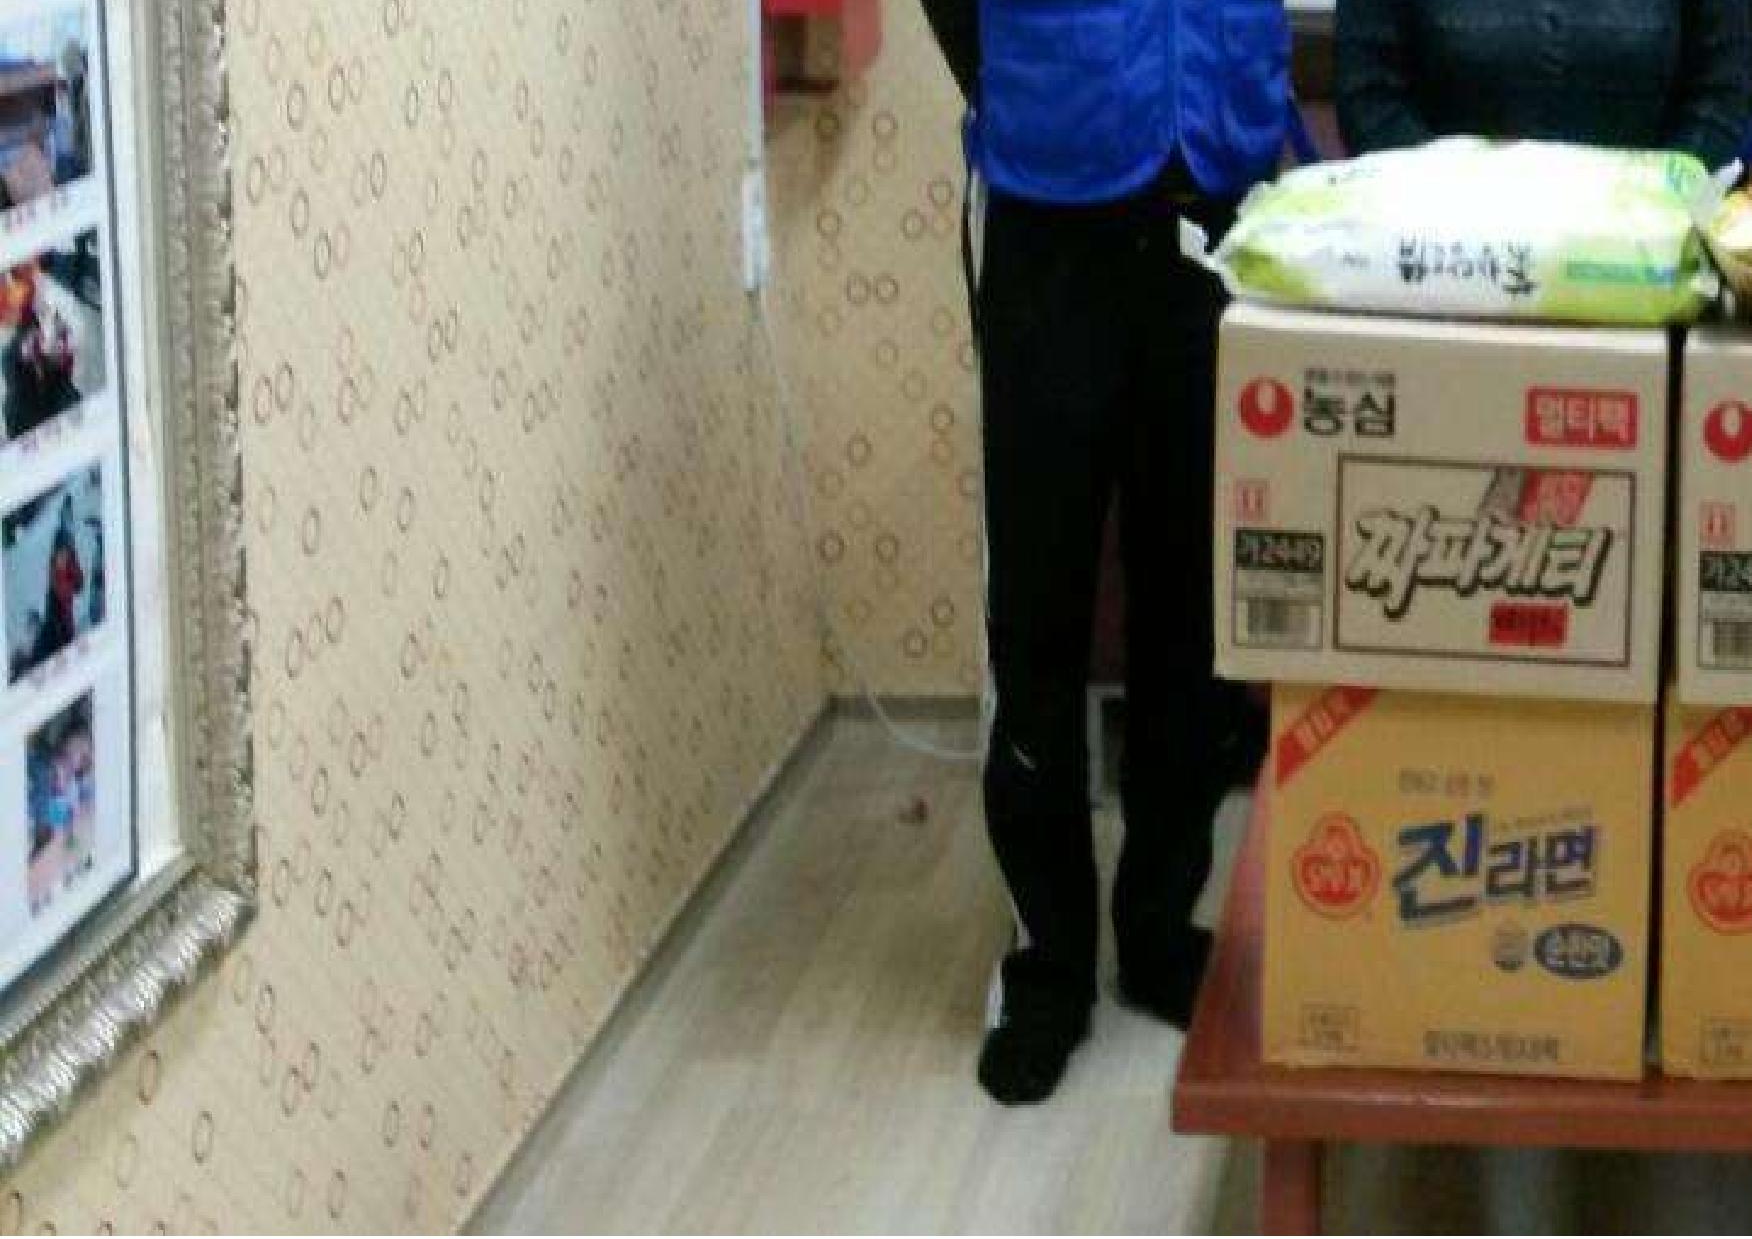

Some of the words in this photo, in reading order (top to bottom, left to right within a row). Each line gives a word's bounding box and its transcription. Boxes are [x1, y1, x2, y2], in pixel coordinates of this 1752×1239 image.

[1303, 386, 1396, 438] 농심
[1532, 395, 1630, 443] 멀티팩
[1344, 504, 1614, 622] 짜파게티
[1392, 812, 1600, 928] 진라면
